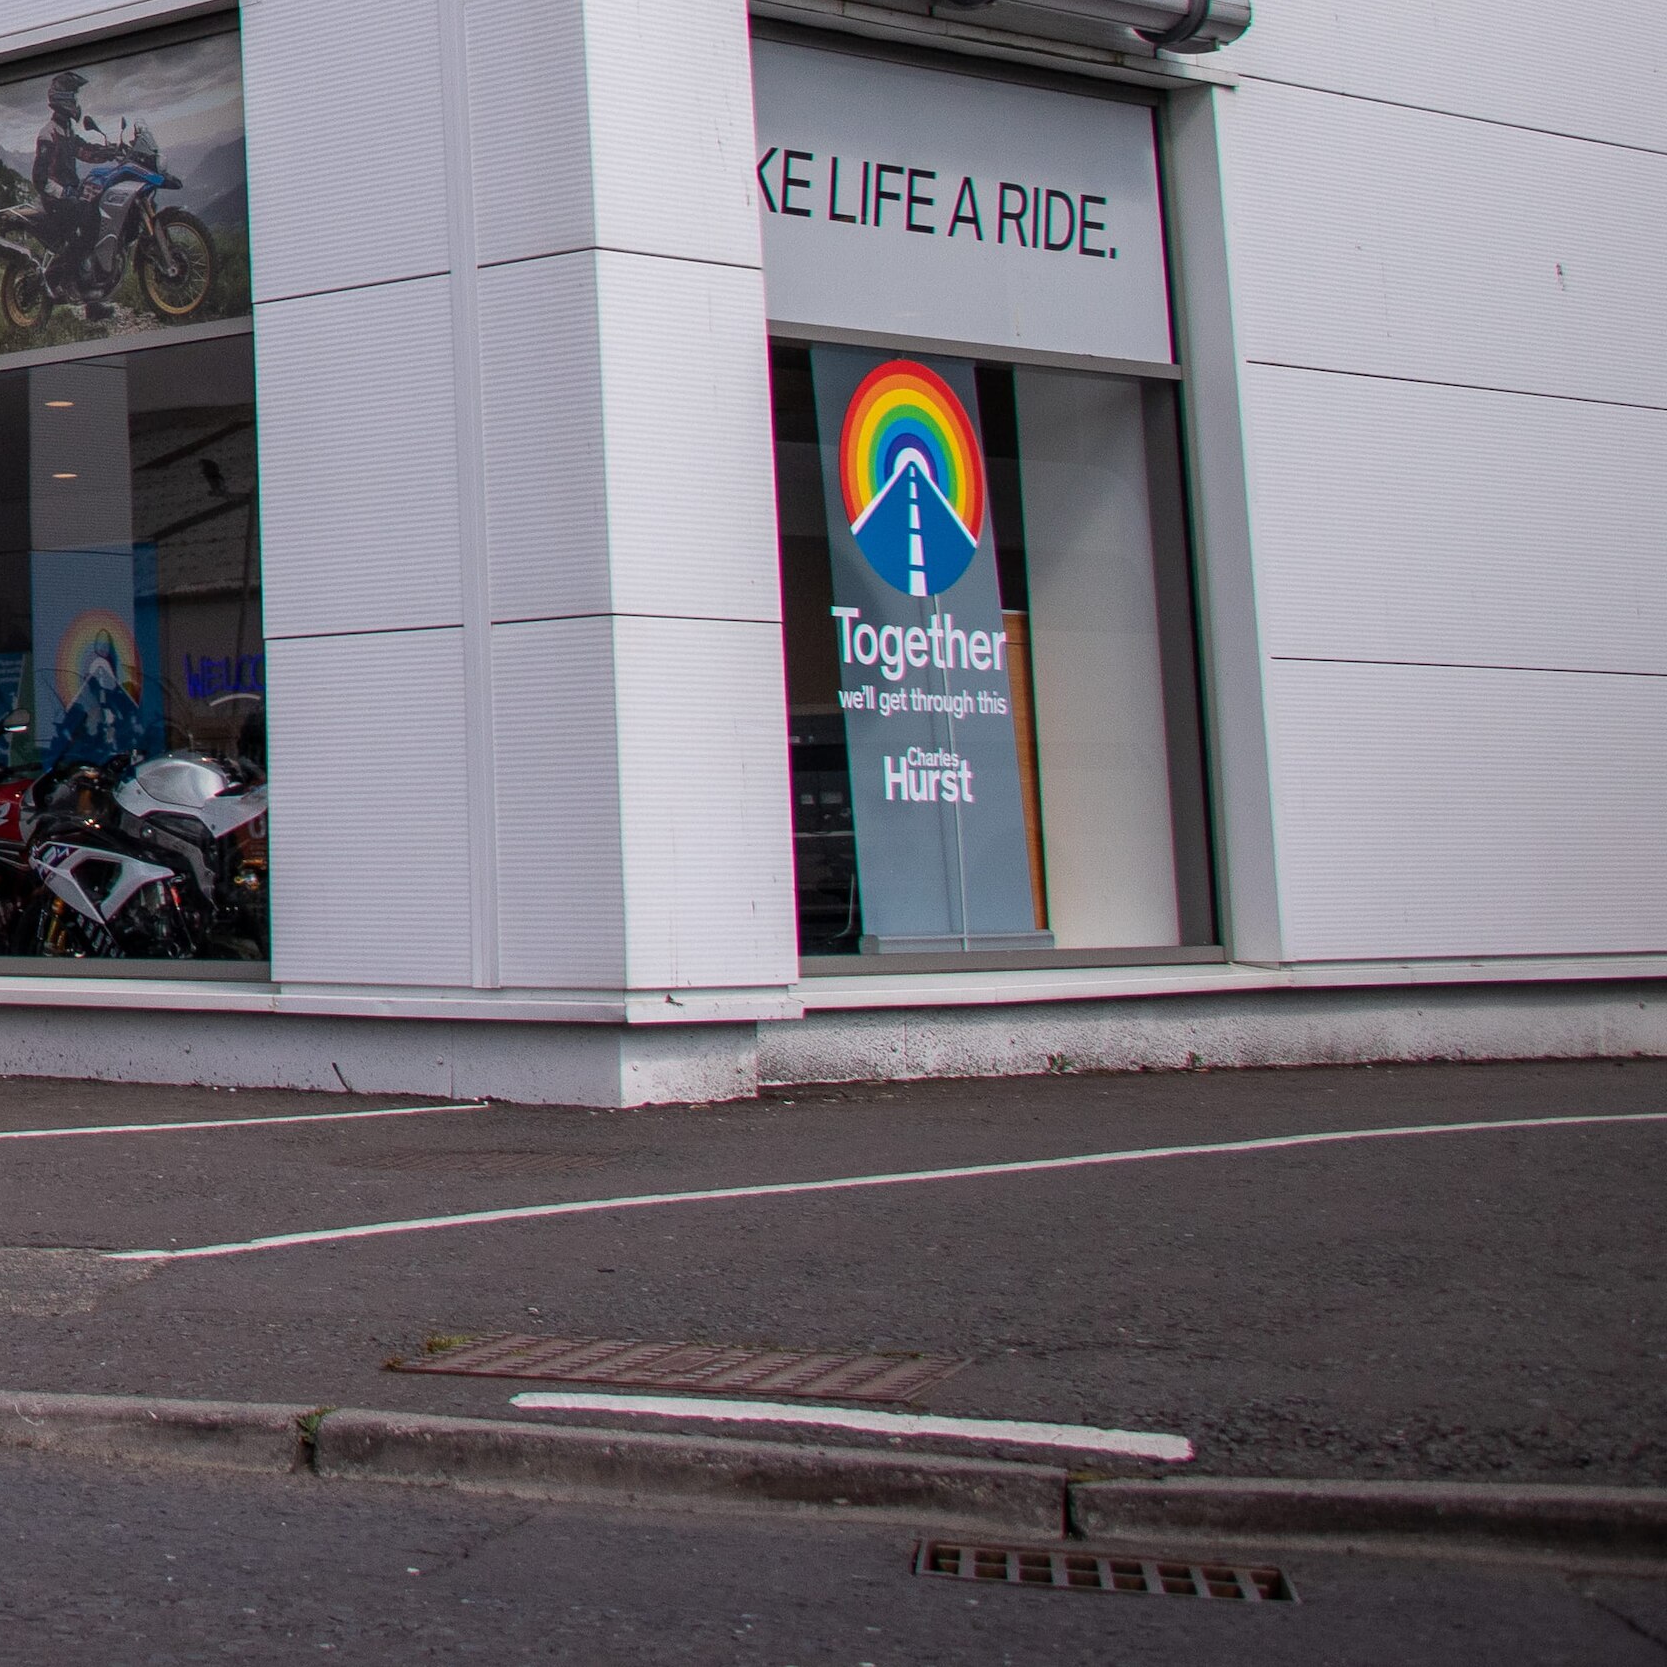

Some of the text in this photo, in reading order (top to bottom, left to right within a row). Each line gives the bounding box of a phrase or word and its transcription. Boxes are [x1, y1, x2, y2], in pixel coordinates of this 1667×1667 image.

[828, 155, 937, 235] LIFE
[947, 176, 984, 242] A
[997, 181, 1118, 260] RIDE.
[830, 606, 1007, 681] Together
[838, 684, 1008, 719] we'll get through this
[883, 755, 975, 803] Hurst
[906, 746, 960, 769] Charles
